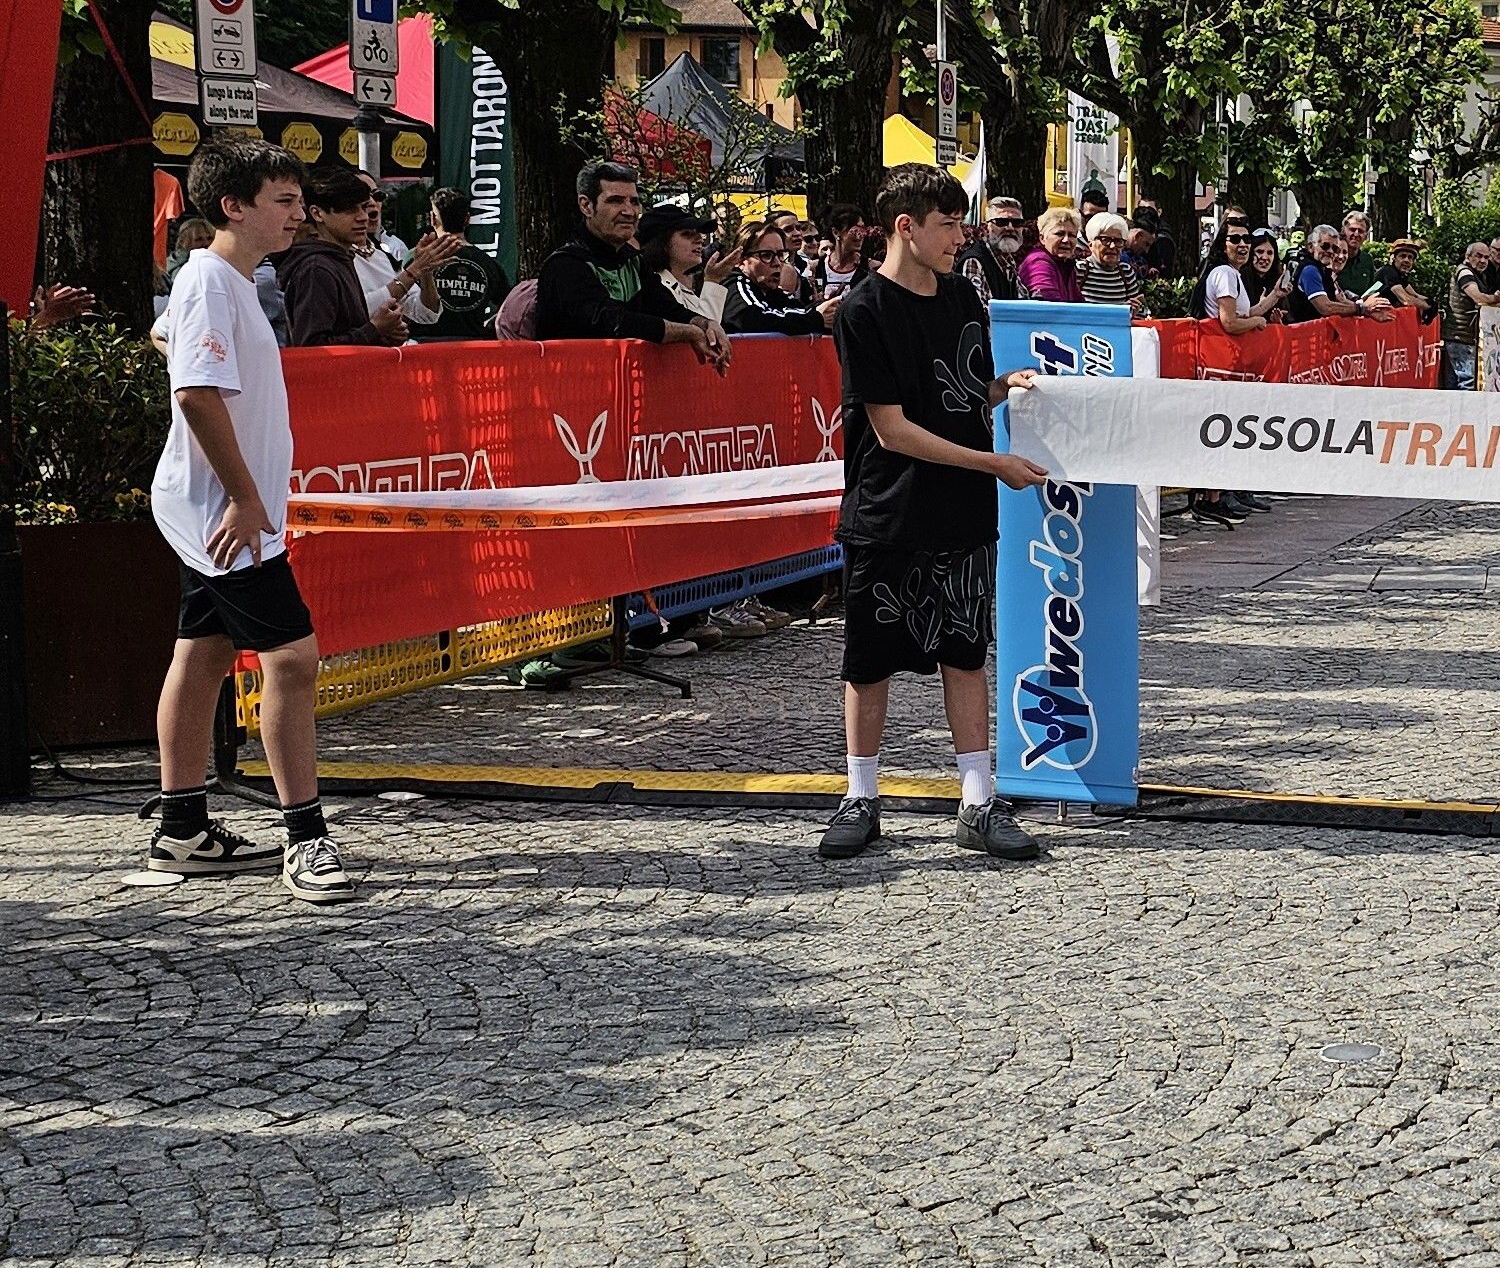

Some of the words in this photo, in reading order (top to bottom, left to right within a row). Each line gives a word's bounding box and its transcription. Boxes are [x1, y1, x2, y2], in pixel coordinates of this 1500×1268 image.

[207, 85, 225, 101] lungo
[234, 87, 253, 101] strada
[210, 105, 227, 120] along
[229, 106, 239, 118] the
[240, 107, 253, 119] road
[1076, 105, 1108, 120] TRAIL
[436, 279, 469, 290] TEMPLE
[470, 282, 486, 294] BAR
